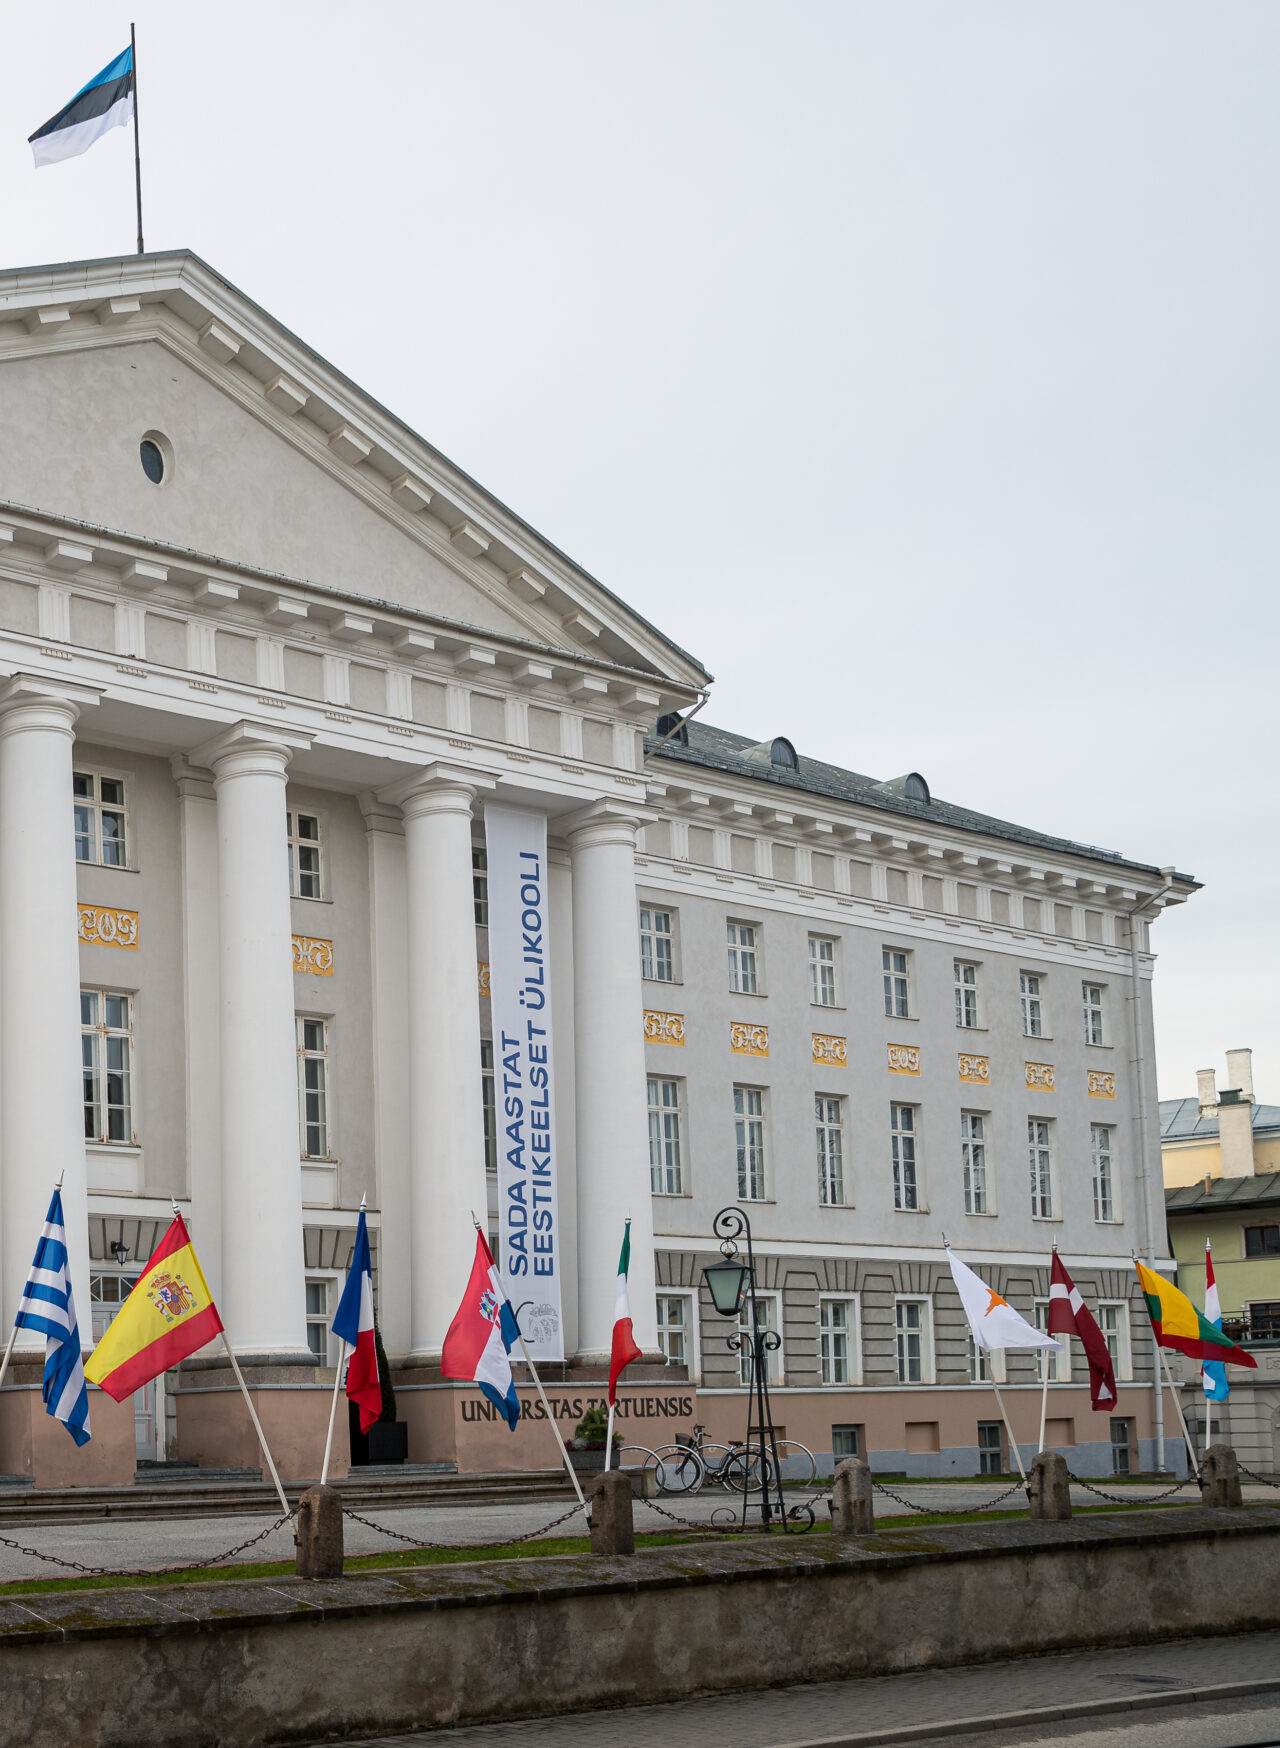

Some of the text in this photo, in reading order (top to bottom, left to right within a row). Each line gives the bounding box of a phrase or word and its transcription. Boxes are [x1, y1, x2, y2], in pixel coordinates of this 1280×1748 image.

[502, 1030, 528, 1276] SADA AASTAT
[519, 852, 553, 1276] EESTIKEELSET ÜLIKOOLI
[461, 1398, 583, 1422] UNIRSTAS
